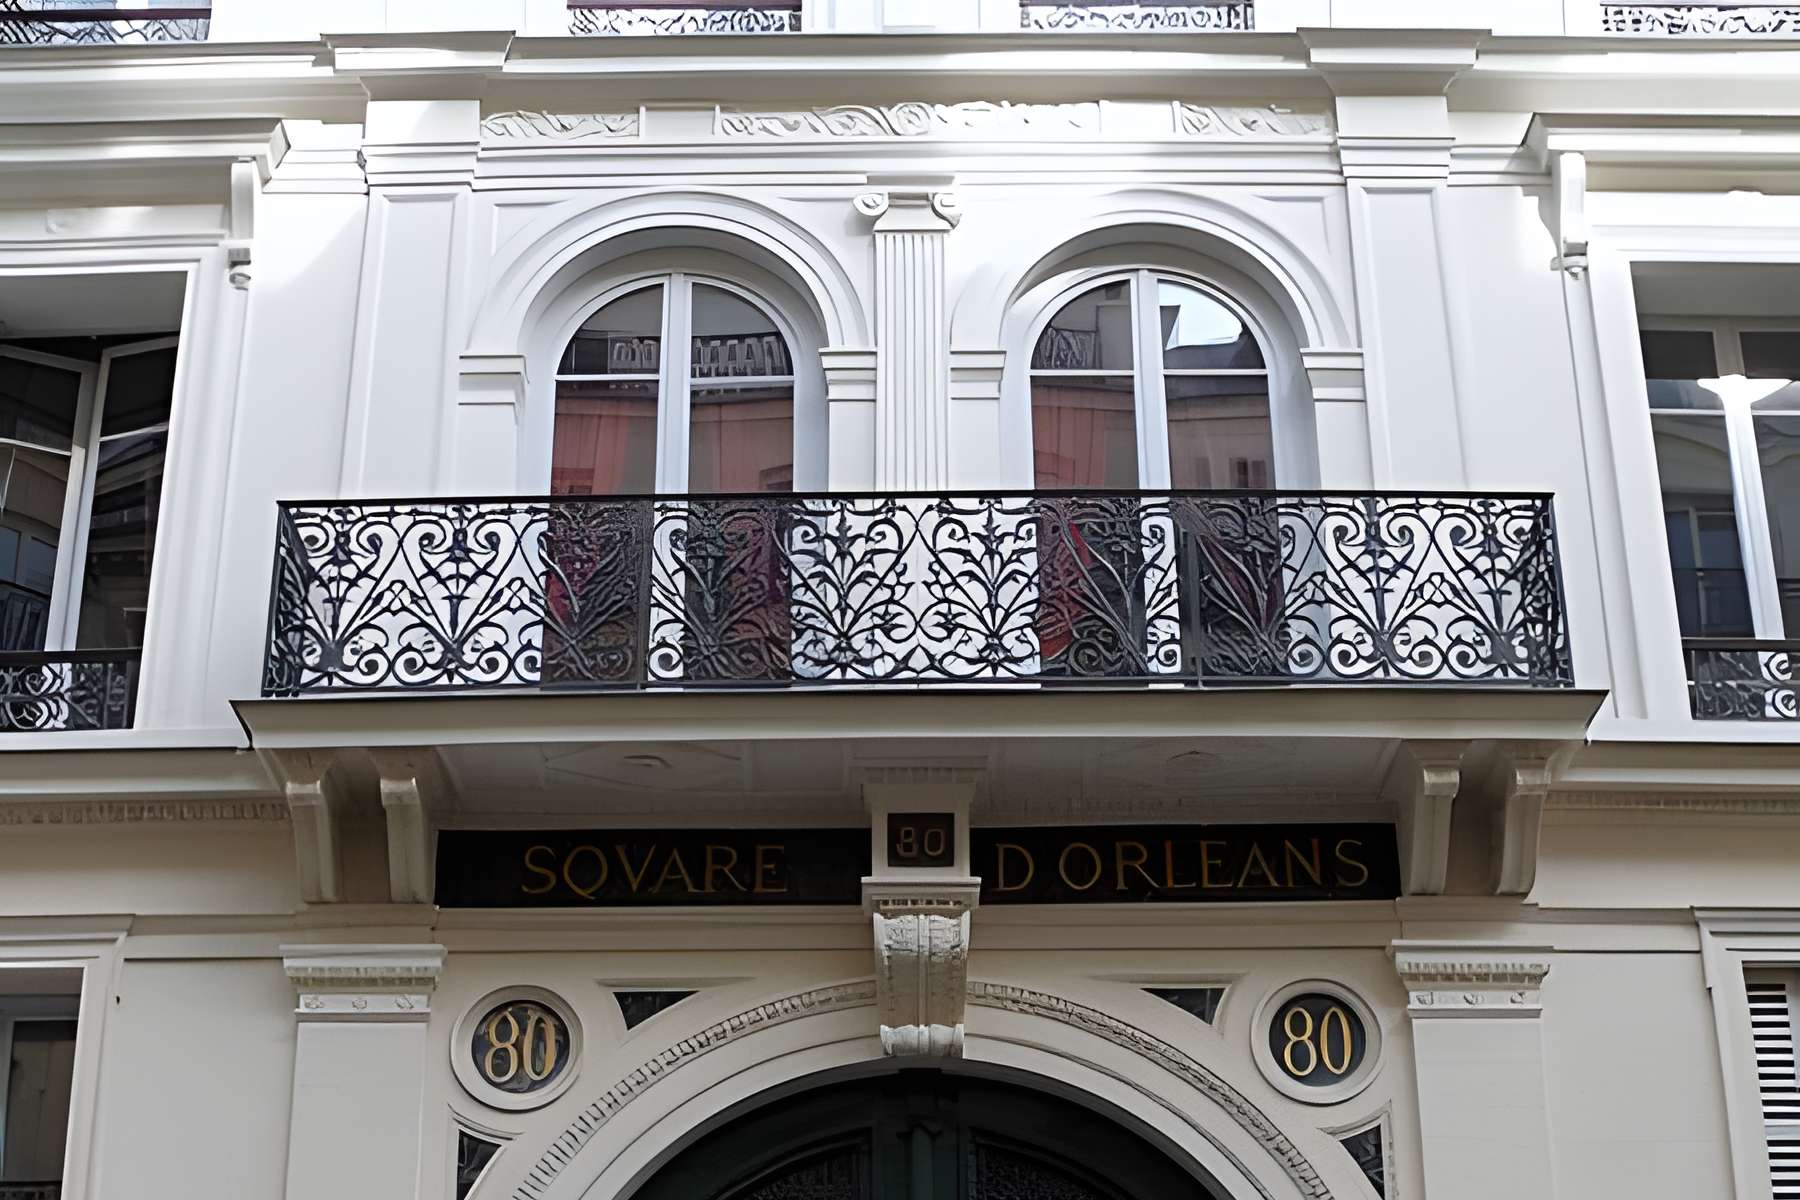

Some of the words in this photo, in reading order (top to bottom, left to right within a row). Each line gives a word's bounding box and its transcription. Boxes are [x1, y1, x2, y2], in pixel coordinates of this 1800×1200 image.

[896, 826, 945, 858] 80
[484, 1008, 558, 1084] 80
[1283, 1006, 1352, 1076] 80
